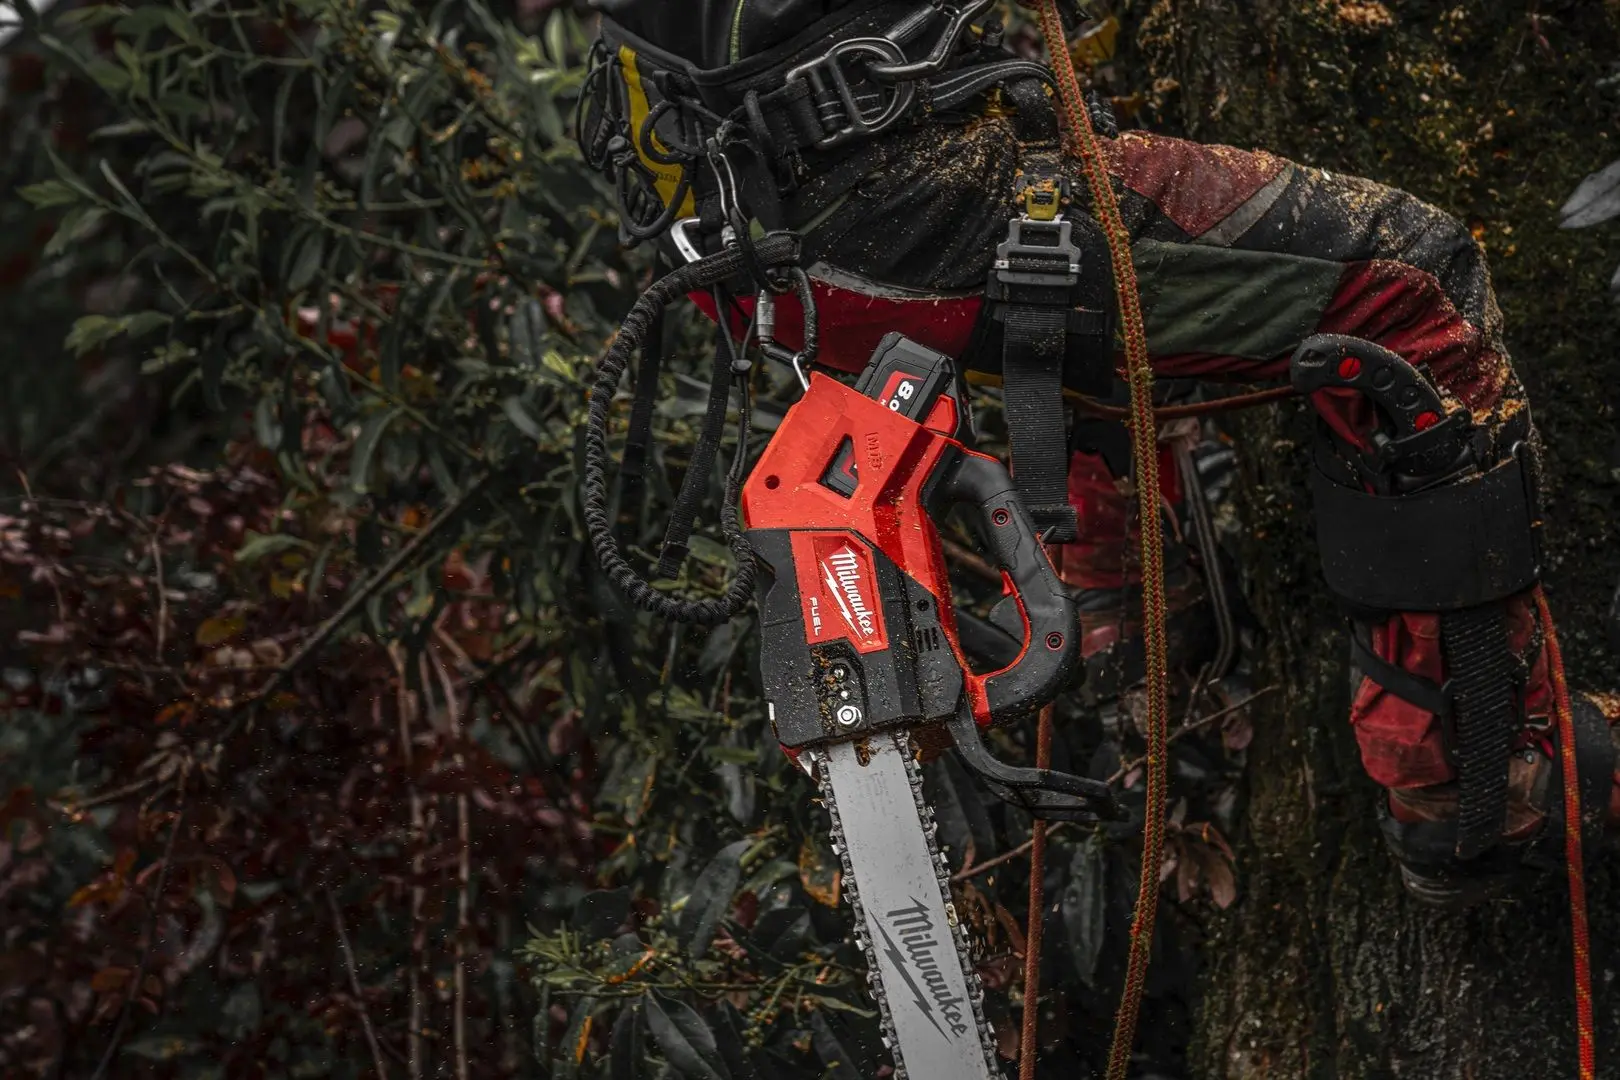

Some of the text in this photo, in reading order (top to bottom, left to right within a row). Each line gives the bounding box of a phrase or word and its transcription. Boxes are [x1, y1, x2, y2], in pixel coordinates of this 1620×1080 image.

[889, 380, 914, 411] 8.0
[809, 597, 822, 636] FUEL
[829, 546, 874, 637] Milwaukee
[886, 895, 968, 1038] Milwaukee
